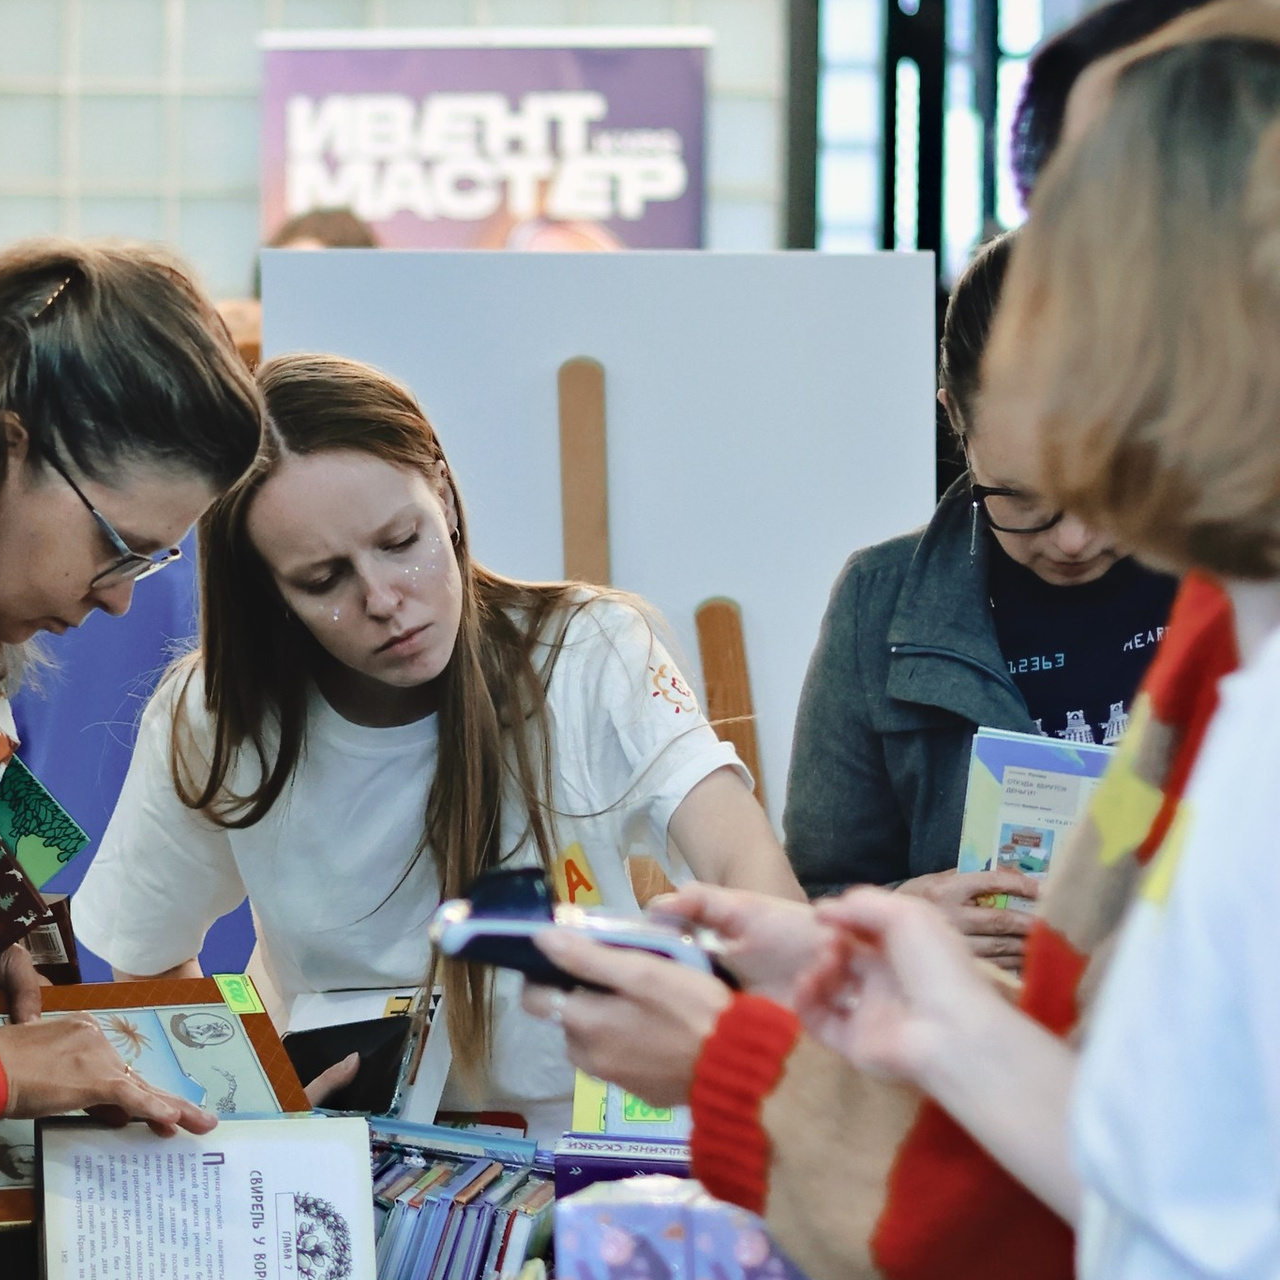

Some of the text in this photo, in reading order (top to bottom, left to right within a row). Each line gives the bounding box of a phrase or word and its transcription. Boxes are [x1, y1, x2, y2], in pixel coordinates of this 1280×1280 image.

[285, 90, 607, 157] ИВЕНТ
[287, 153, 688, 221] МАСТЕР
[132, 1154, 138, 1164] от
[568, 1141, 623, 1152] СКАЗКИ
[96, 1165, 105, 1201] рассвета
[191, 1163, 199, 1188] самой
[87, 1187, 95, 1199] Он
[110, 1190, 117, 1200] от
[132, 1169, 143, 1235] прикосновений
[250, 1170, 264, 1229] СВИРЕЛЬ
[75, 1190, 83, 1229] отпустив
[122, 1210, 130, 1230] Крот
[156, 1194, 165, 1244] угасающим
[77, 1235, 85, 1263] Крыса
[192, 1233, 200, 1267] речного
[253, 1236, 265, 1245] У
[282, 1231, 292, 1260] ГЛАВА
[113, 1256, 122, 1270] без
[184, 1257, 189, 1268] но
